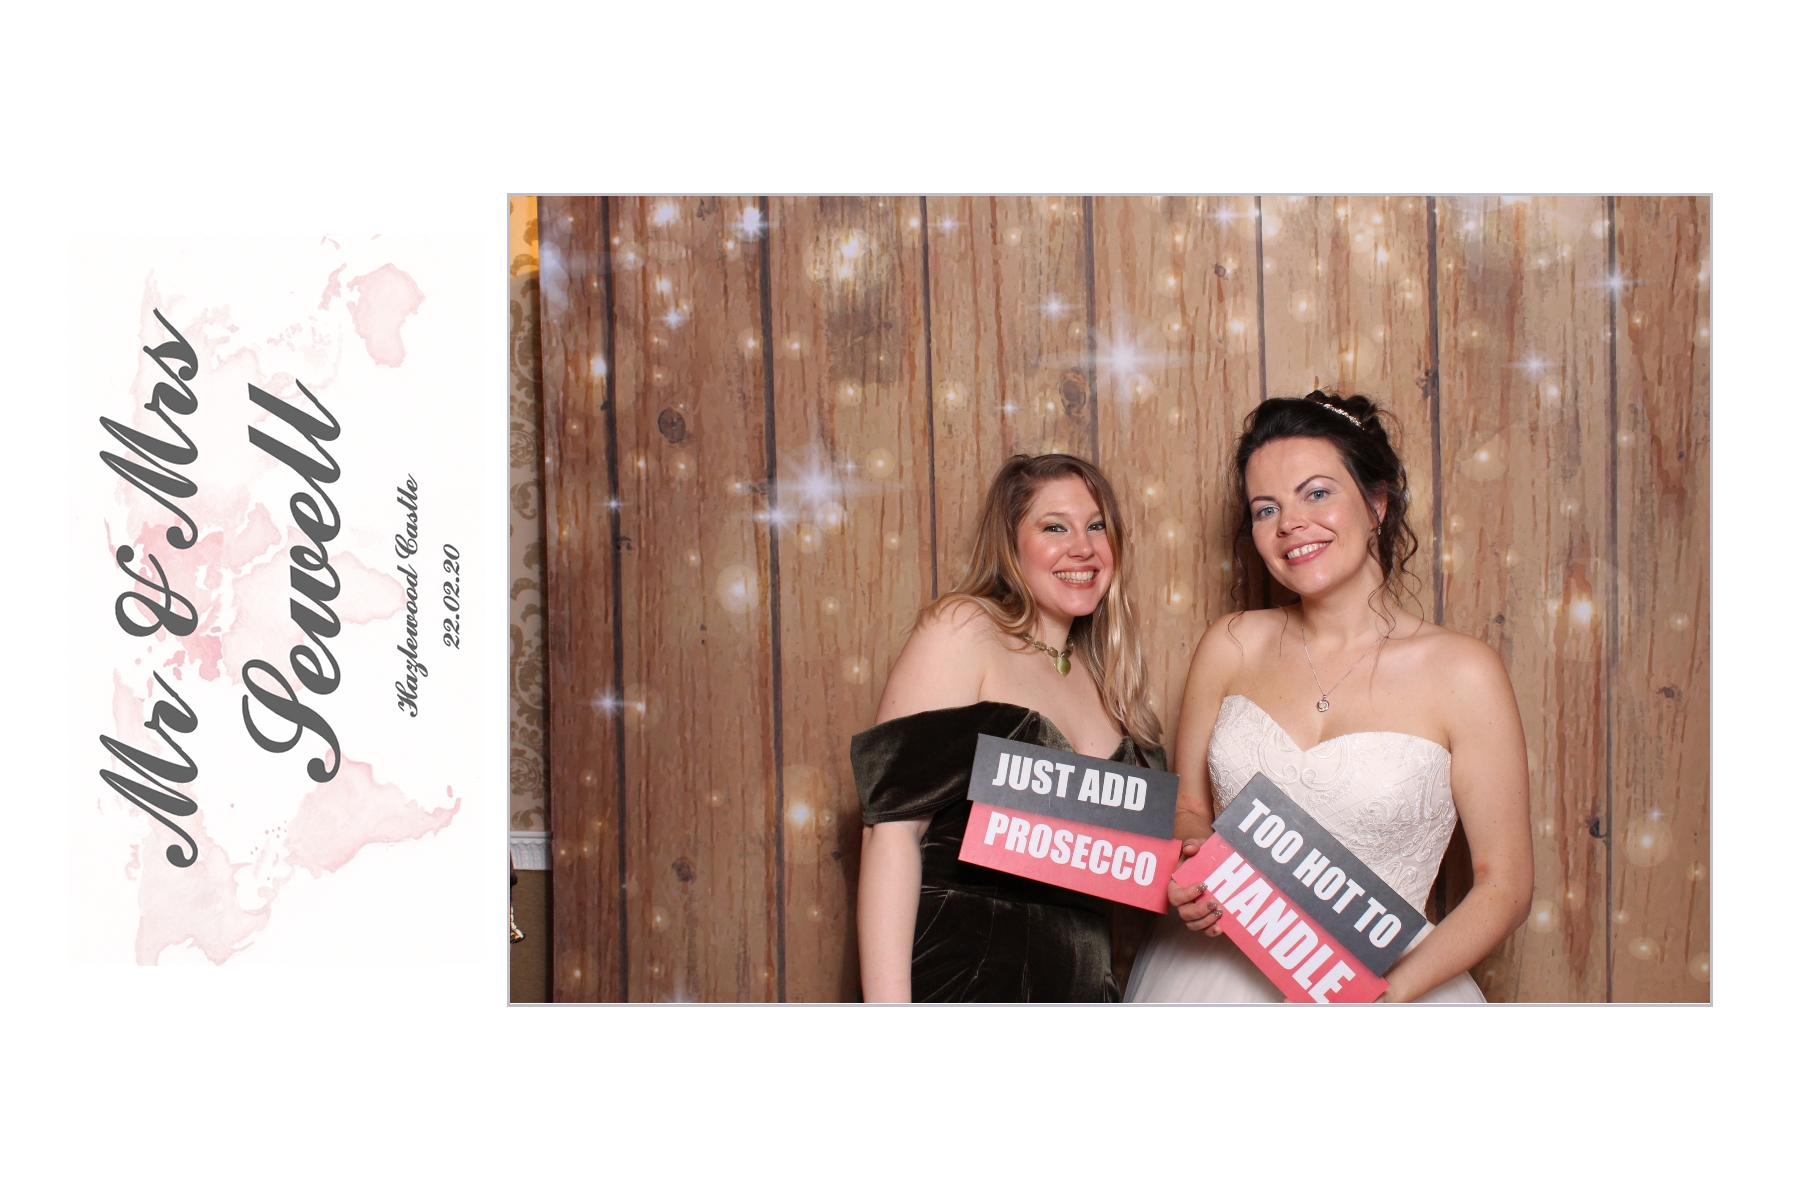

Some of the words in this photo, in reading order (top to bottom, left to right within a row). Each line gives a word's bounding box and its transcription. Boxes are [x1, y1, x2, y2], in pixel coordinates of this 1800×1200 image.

[991, 752, 1076, 799] JUST
[1077, 768, 1148, 812] ADD
[983, 810, 1158, 887] PROSECCO
[1237, 797, 1304, 864] TOO
[1292, 847, 1366, 914] HOT
[1353, 896, 1402, 949] TO
[1203, 851, 1357, 1003] HANDLE
